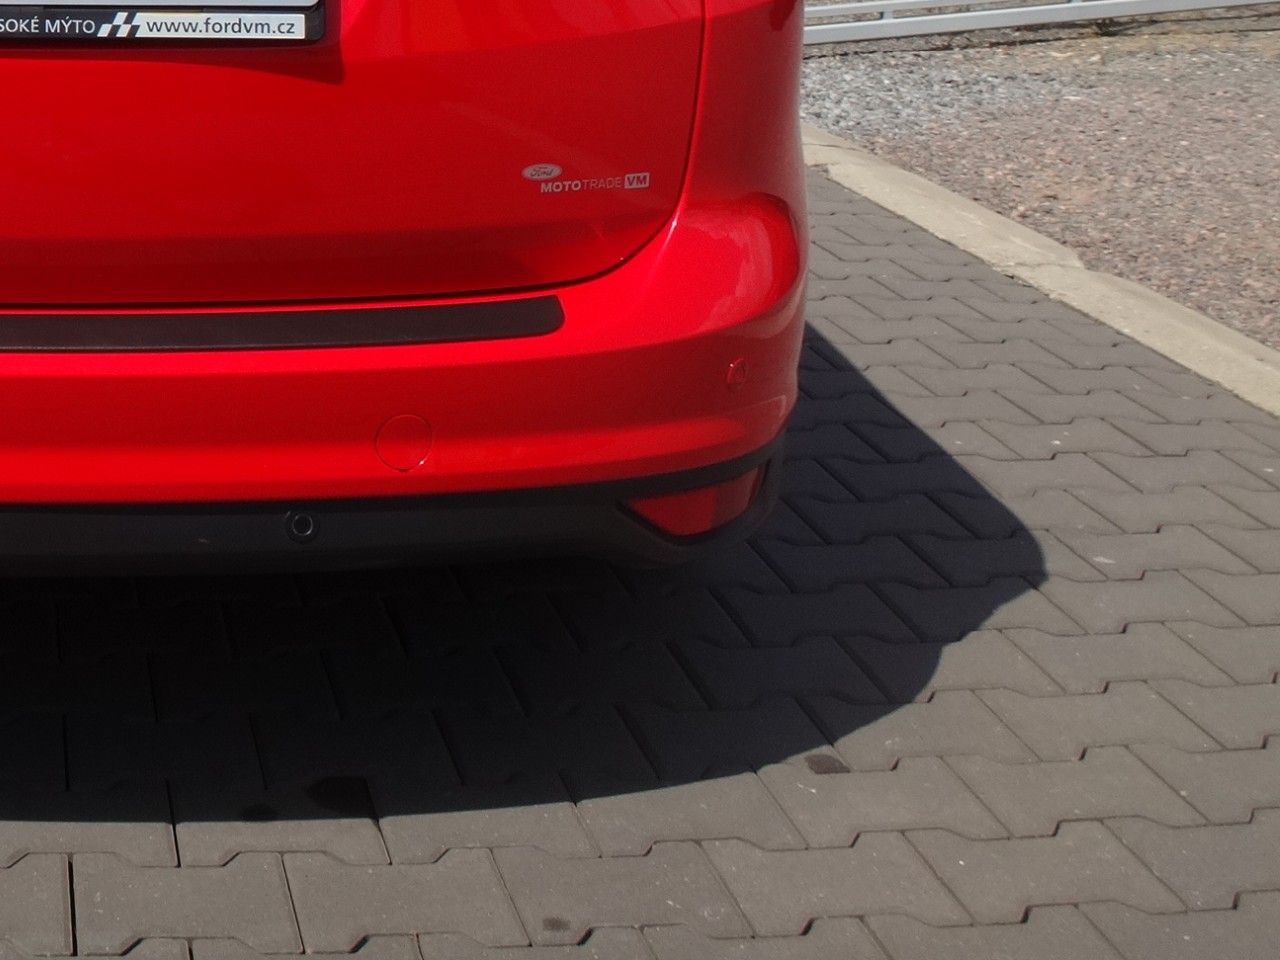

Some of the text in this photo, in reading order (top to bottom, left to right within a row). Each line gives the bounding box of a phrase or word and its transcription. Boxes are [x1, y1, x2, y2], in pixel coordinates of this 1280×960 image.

[45, 16, 96, 33] MÝTO
[146, 17, 296, 34] www.fordvm.cz
[627, 175, 648, 187] VM
